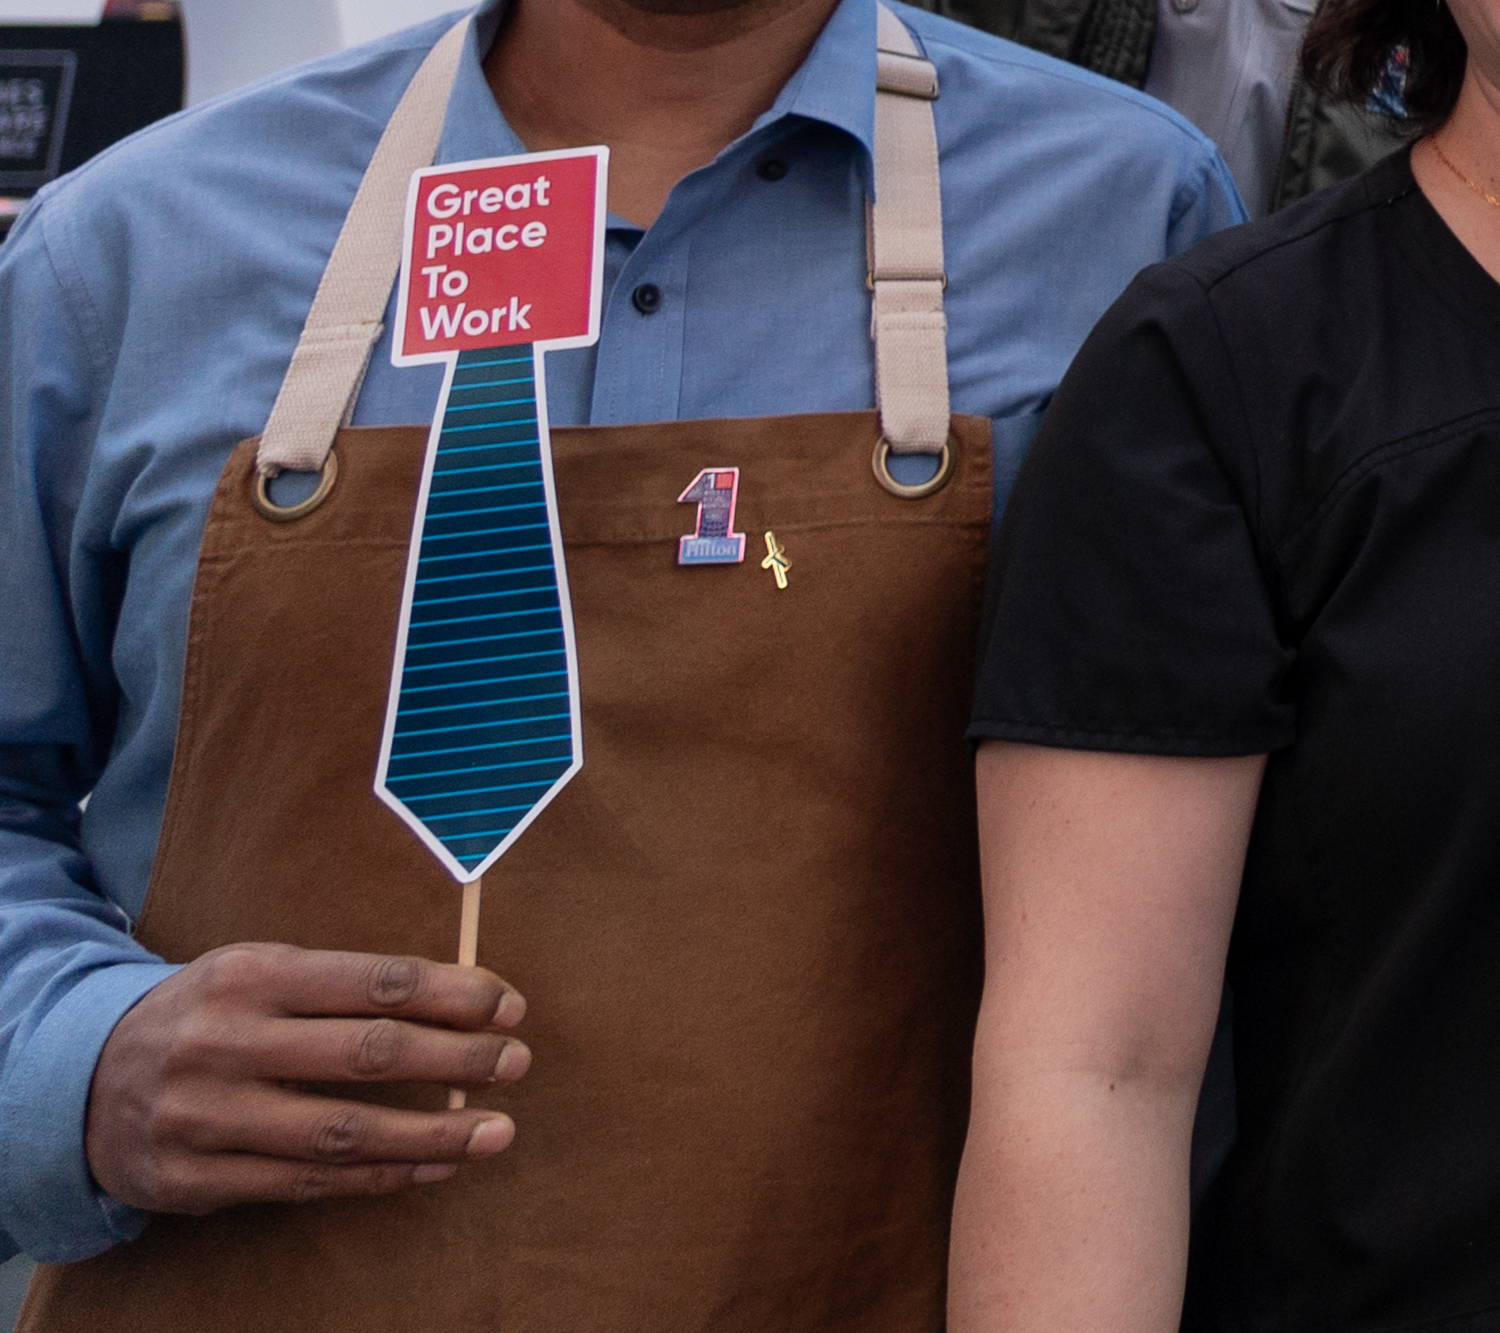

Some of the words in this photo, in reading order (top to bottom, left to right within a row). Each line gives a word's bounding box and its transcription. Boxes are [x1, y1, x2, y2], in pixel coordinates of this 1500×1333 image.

[426, 175, 551, 219] Great
[426, 221, 548, 260] Place
[420, 264, 469, 299] To
[418, 296, 533, 342] Work
